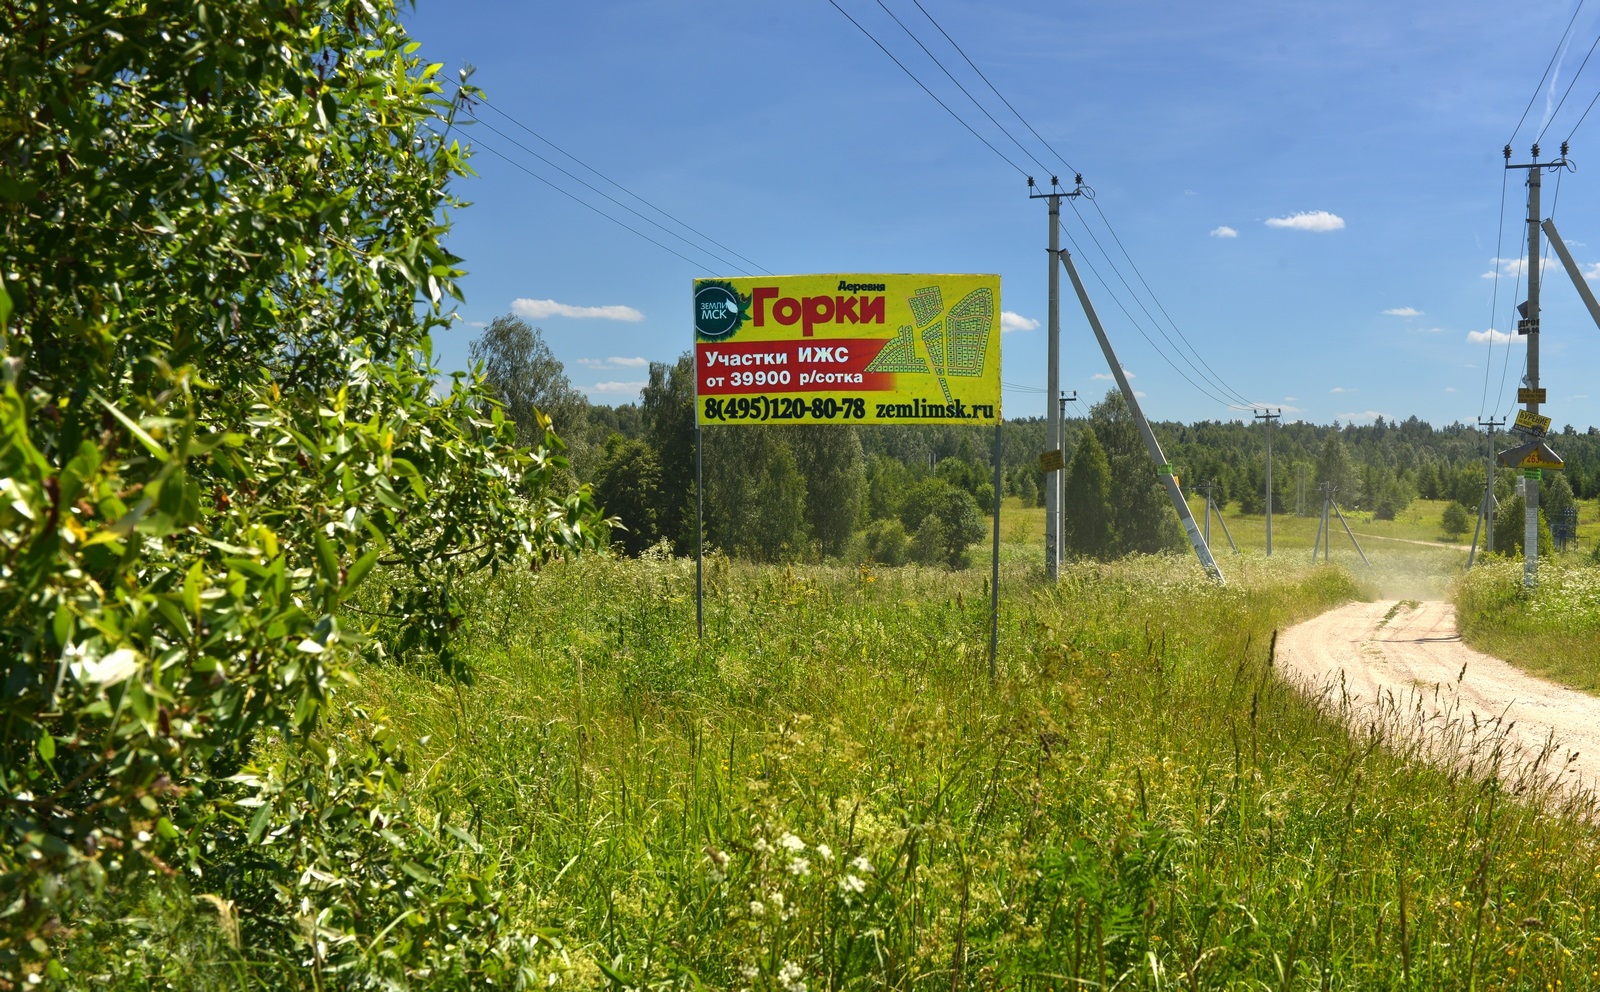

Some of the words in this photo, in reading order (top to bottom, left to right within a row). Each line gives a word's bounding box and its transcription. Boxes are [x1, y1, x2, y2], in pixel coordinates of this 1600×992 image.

[838, 280, 886, 294] Деревня
[700, 302, 727, 310] ЗЕМЛИ
[701, 309, 728, 320] МСК
[752, 287, 886, 337] Горки
[705, 351, 788, 367] Участки
[798, 346, 849, 363] ИЖС
[706, 376, 724, 387] от
[730, 370, 791, 386] 39900
[799, 369, 864, 386] р/сотка
[704, 396, 866, 421] 8(495)120-80-78
[875, 398, 994, 420] zemlimsk.ru
[1519, 411, 1549, 427] БУРЕНИЕ
